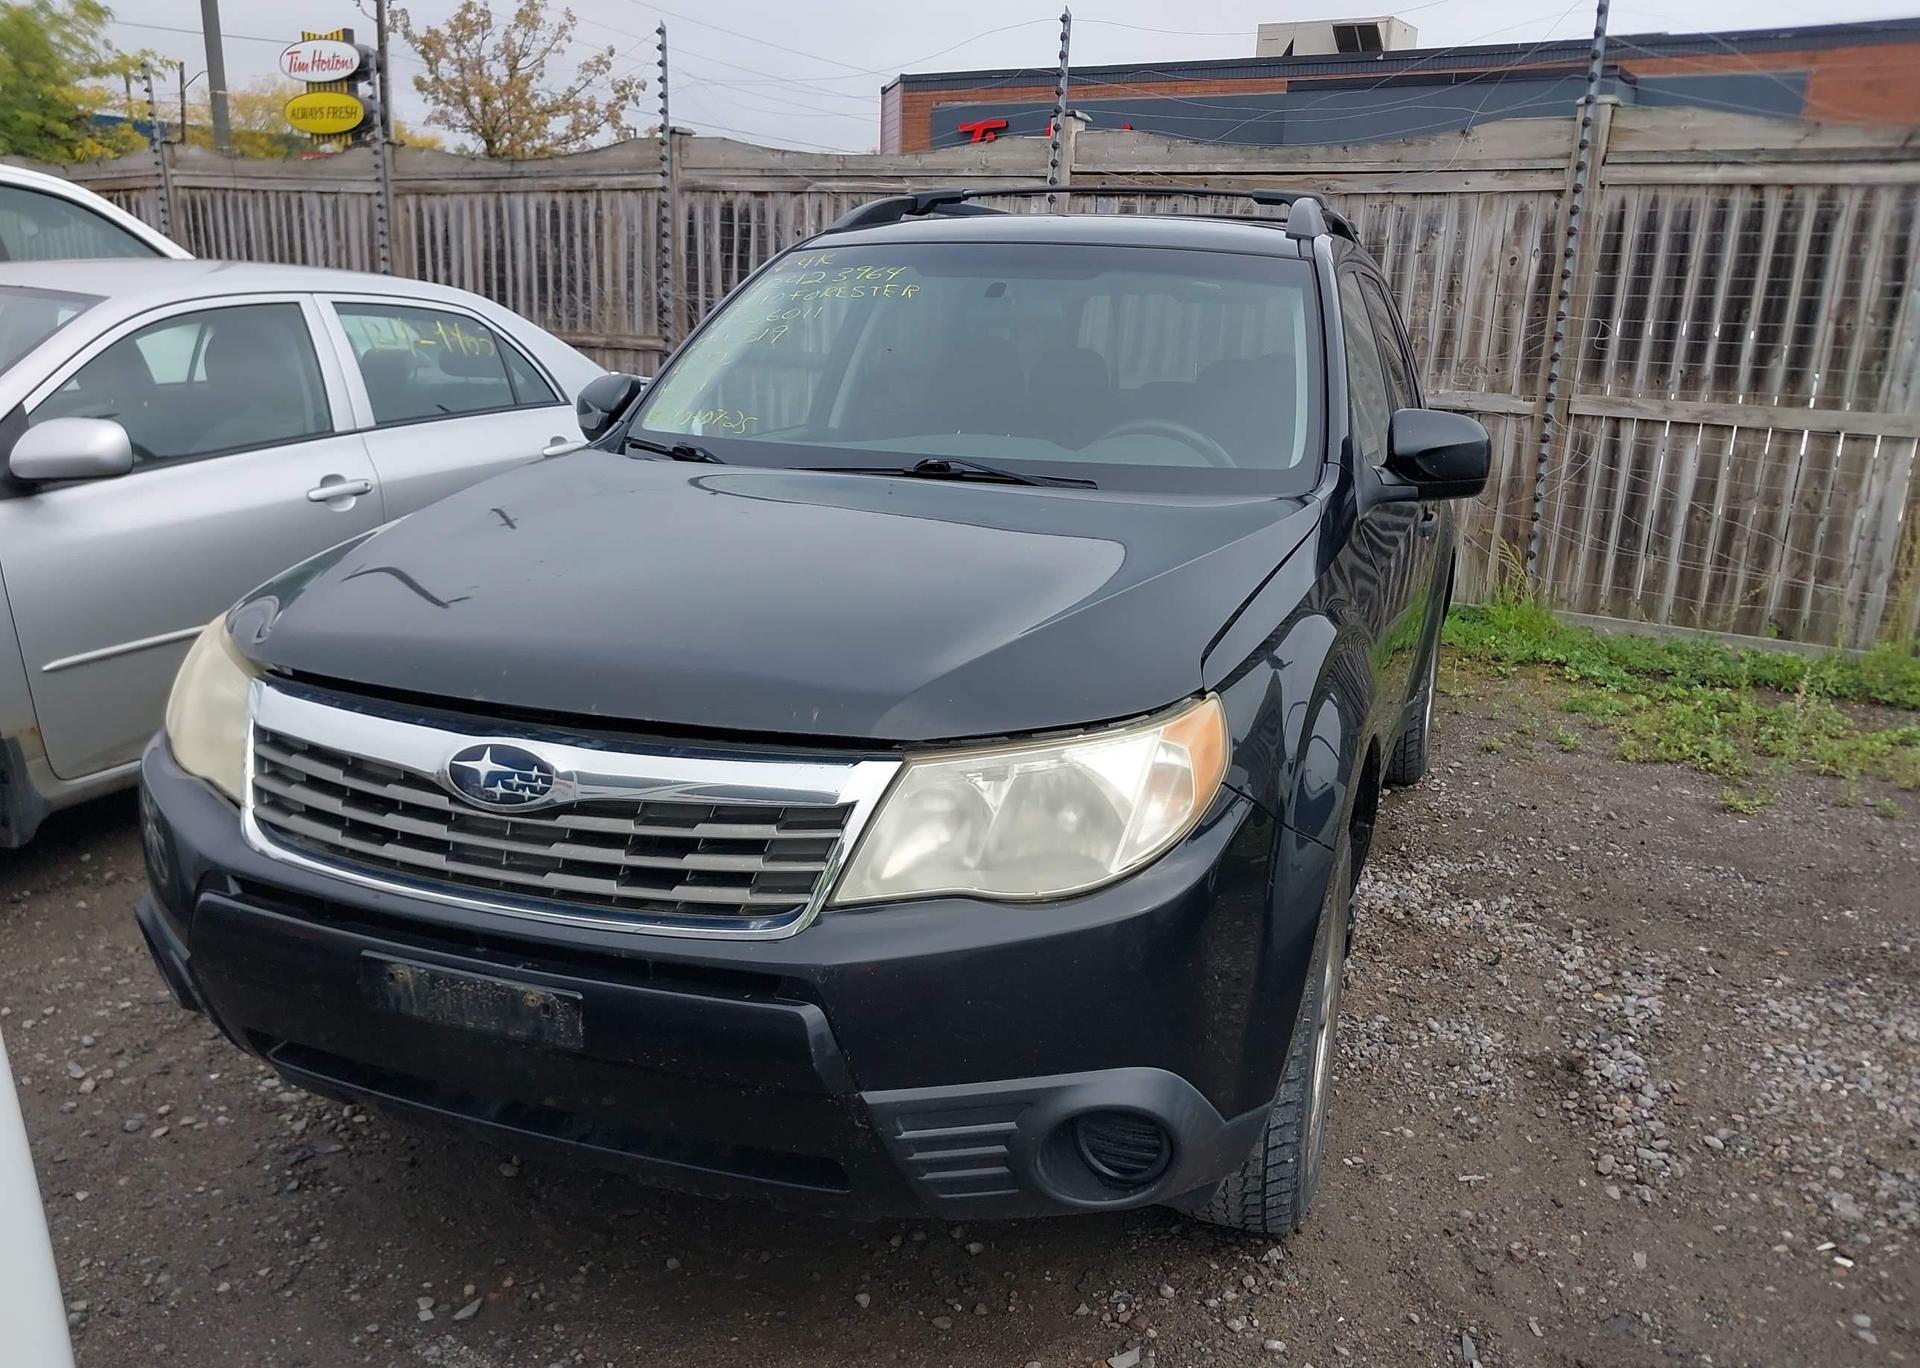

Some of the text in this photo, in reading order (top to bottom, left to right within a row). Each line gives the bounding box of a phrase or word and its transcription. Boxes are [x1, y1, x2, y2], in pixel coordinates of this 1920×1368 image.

[287, 49, 354, 73] Tim Hortons
[290, 105, 358, 121] ALWAYS FRESH
[790, 283, 920, 301] FORESTER
